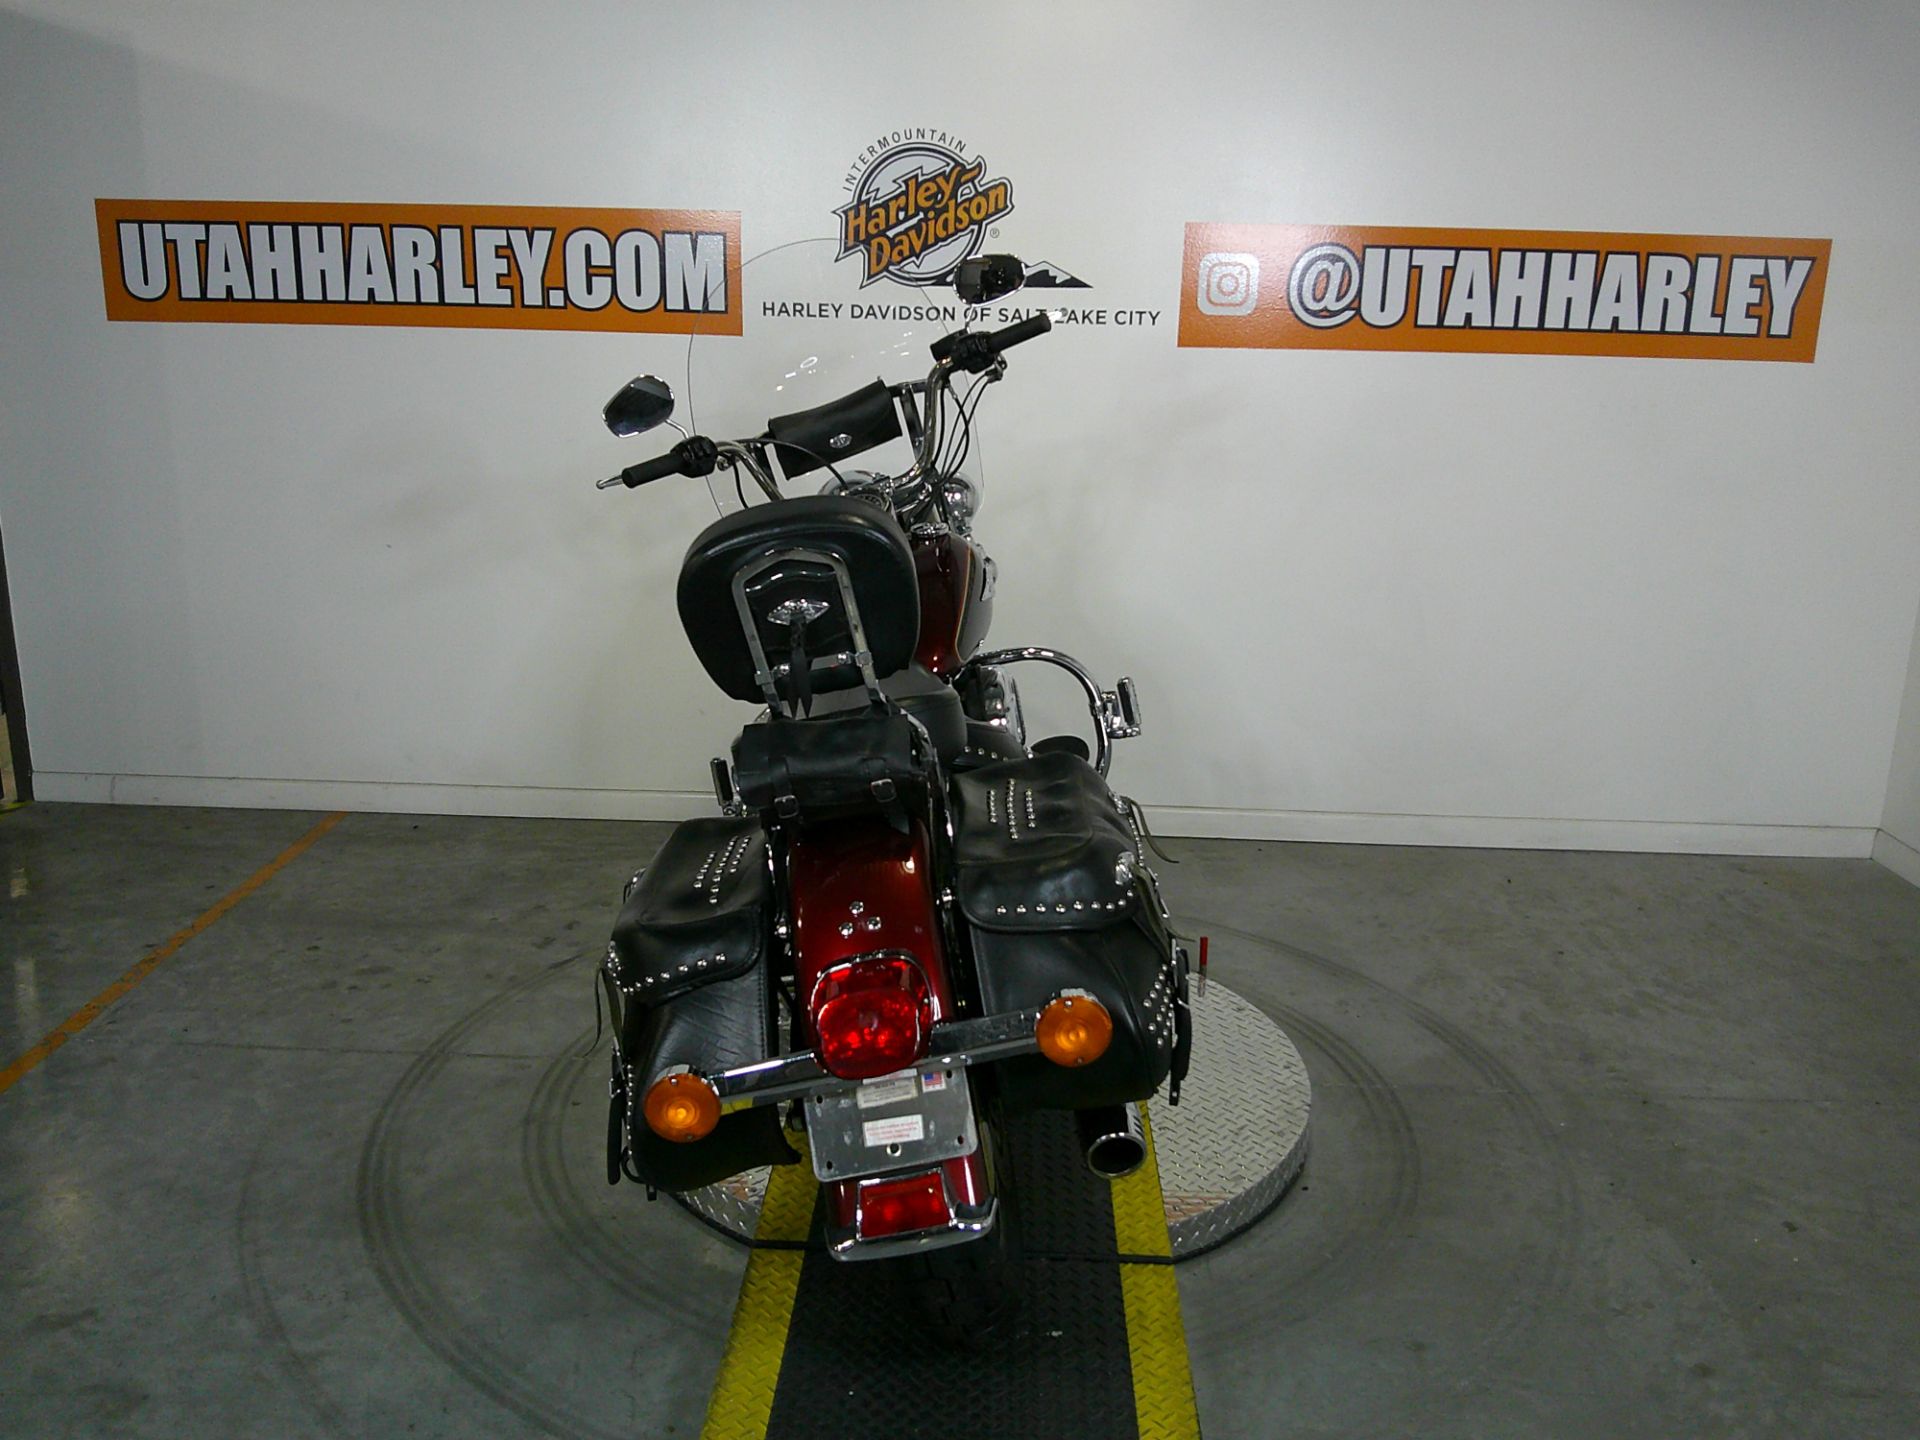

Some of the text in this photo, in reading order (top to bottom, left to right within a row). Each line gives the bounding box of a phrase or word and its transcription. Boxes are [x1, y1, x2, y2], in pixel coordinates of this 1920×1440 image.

[843, 128, 966, 192] INTERMOUNTAIN
[116, 219, 729, 314] UTAHHARLEY.COM
[869, 184, 1006, 276] Davidson
[762, 302, 844, 320] HARLEY
[850, 304, 955, 322] DAVIDSON
[963, 307, 992, 322] OF
[1114, 310, 1161, 326] CITY
[1287, 241, 1817, 338] @UTAHHARLEY
